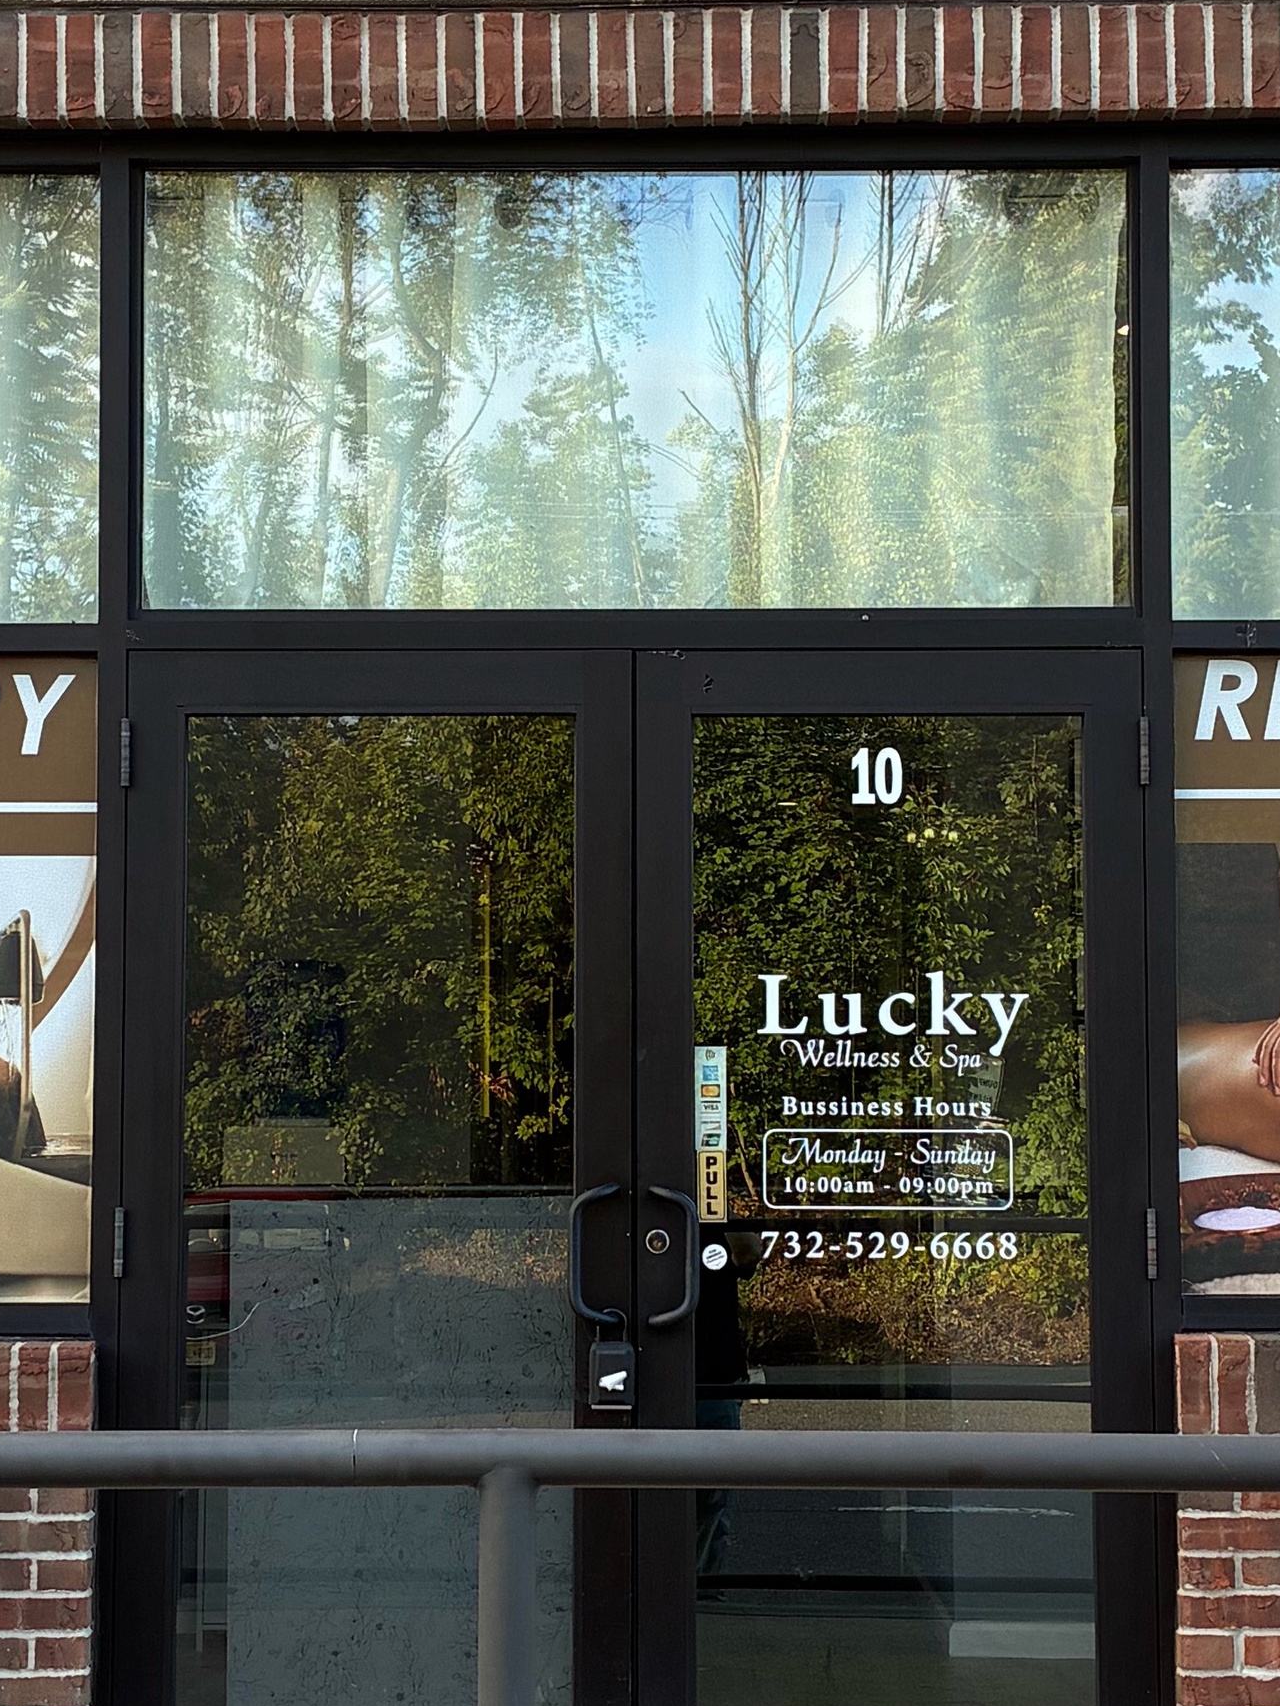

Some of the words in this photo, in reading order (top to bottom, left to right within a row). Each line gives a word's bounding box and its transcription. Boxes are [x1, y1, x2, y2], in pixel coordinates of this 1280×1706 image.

[851, 747, 903, 805] 10
[756, 970, 1030, 1057] Lucky
[779, 1039, 900, 1069] Wellness
[909, 1044, 933, 1068] &
[939, 1043, 983, 1077] Spa
[781, 1096, 904, 1117] Bussiness
[914, 1096, 992, 1118] Hours
[781, 1137, 886, 1174] Monday
[910, 1138, 996, 1174] Sunday
[705, 1155, 718, 1216] PULL
[784, 1176, 875, 1194] 10:00am
[899, 1176, 994, 1199] 09:00pm
[760, 1231, 1018, 1261] 732-529-6668
